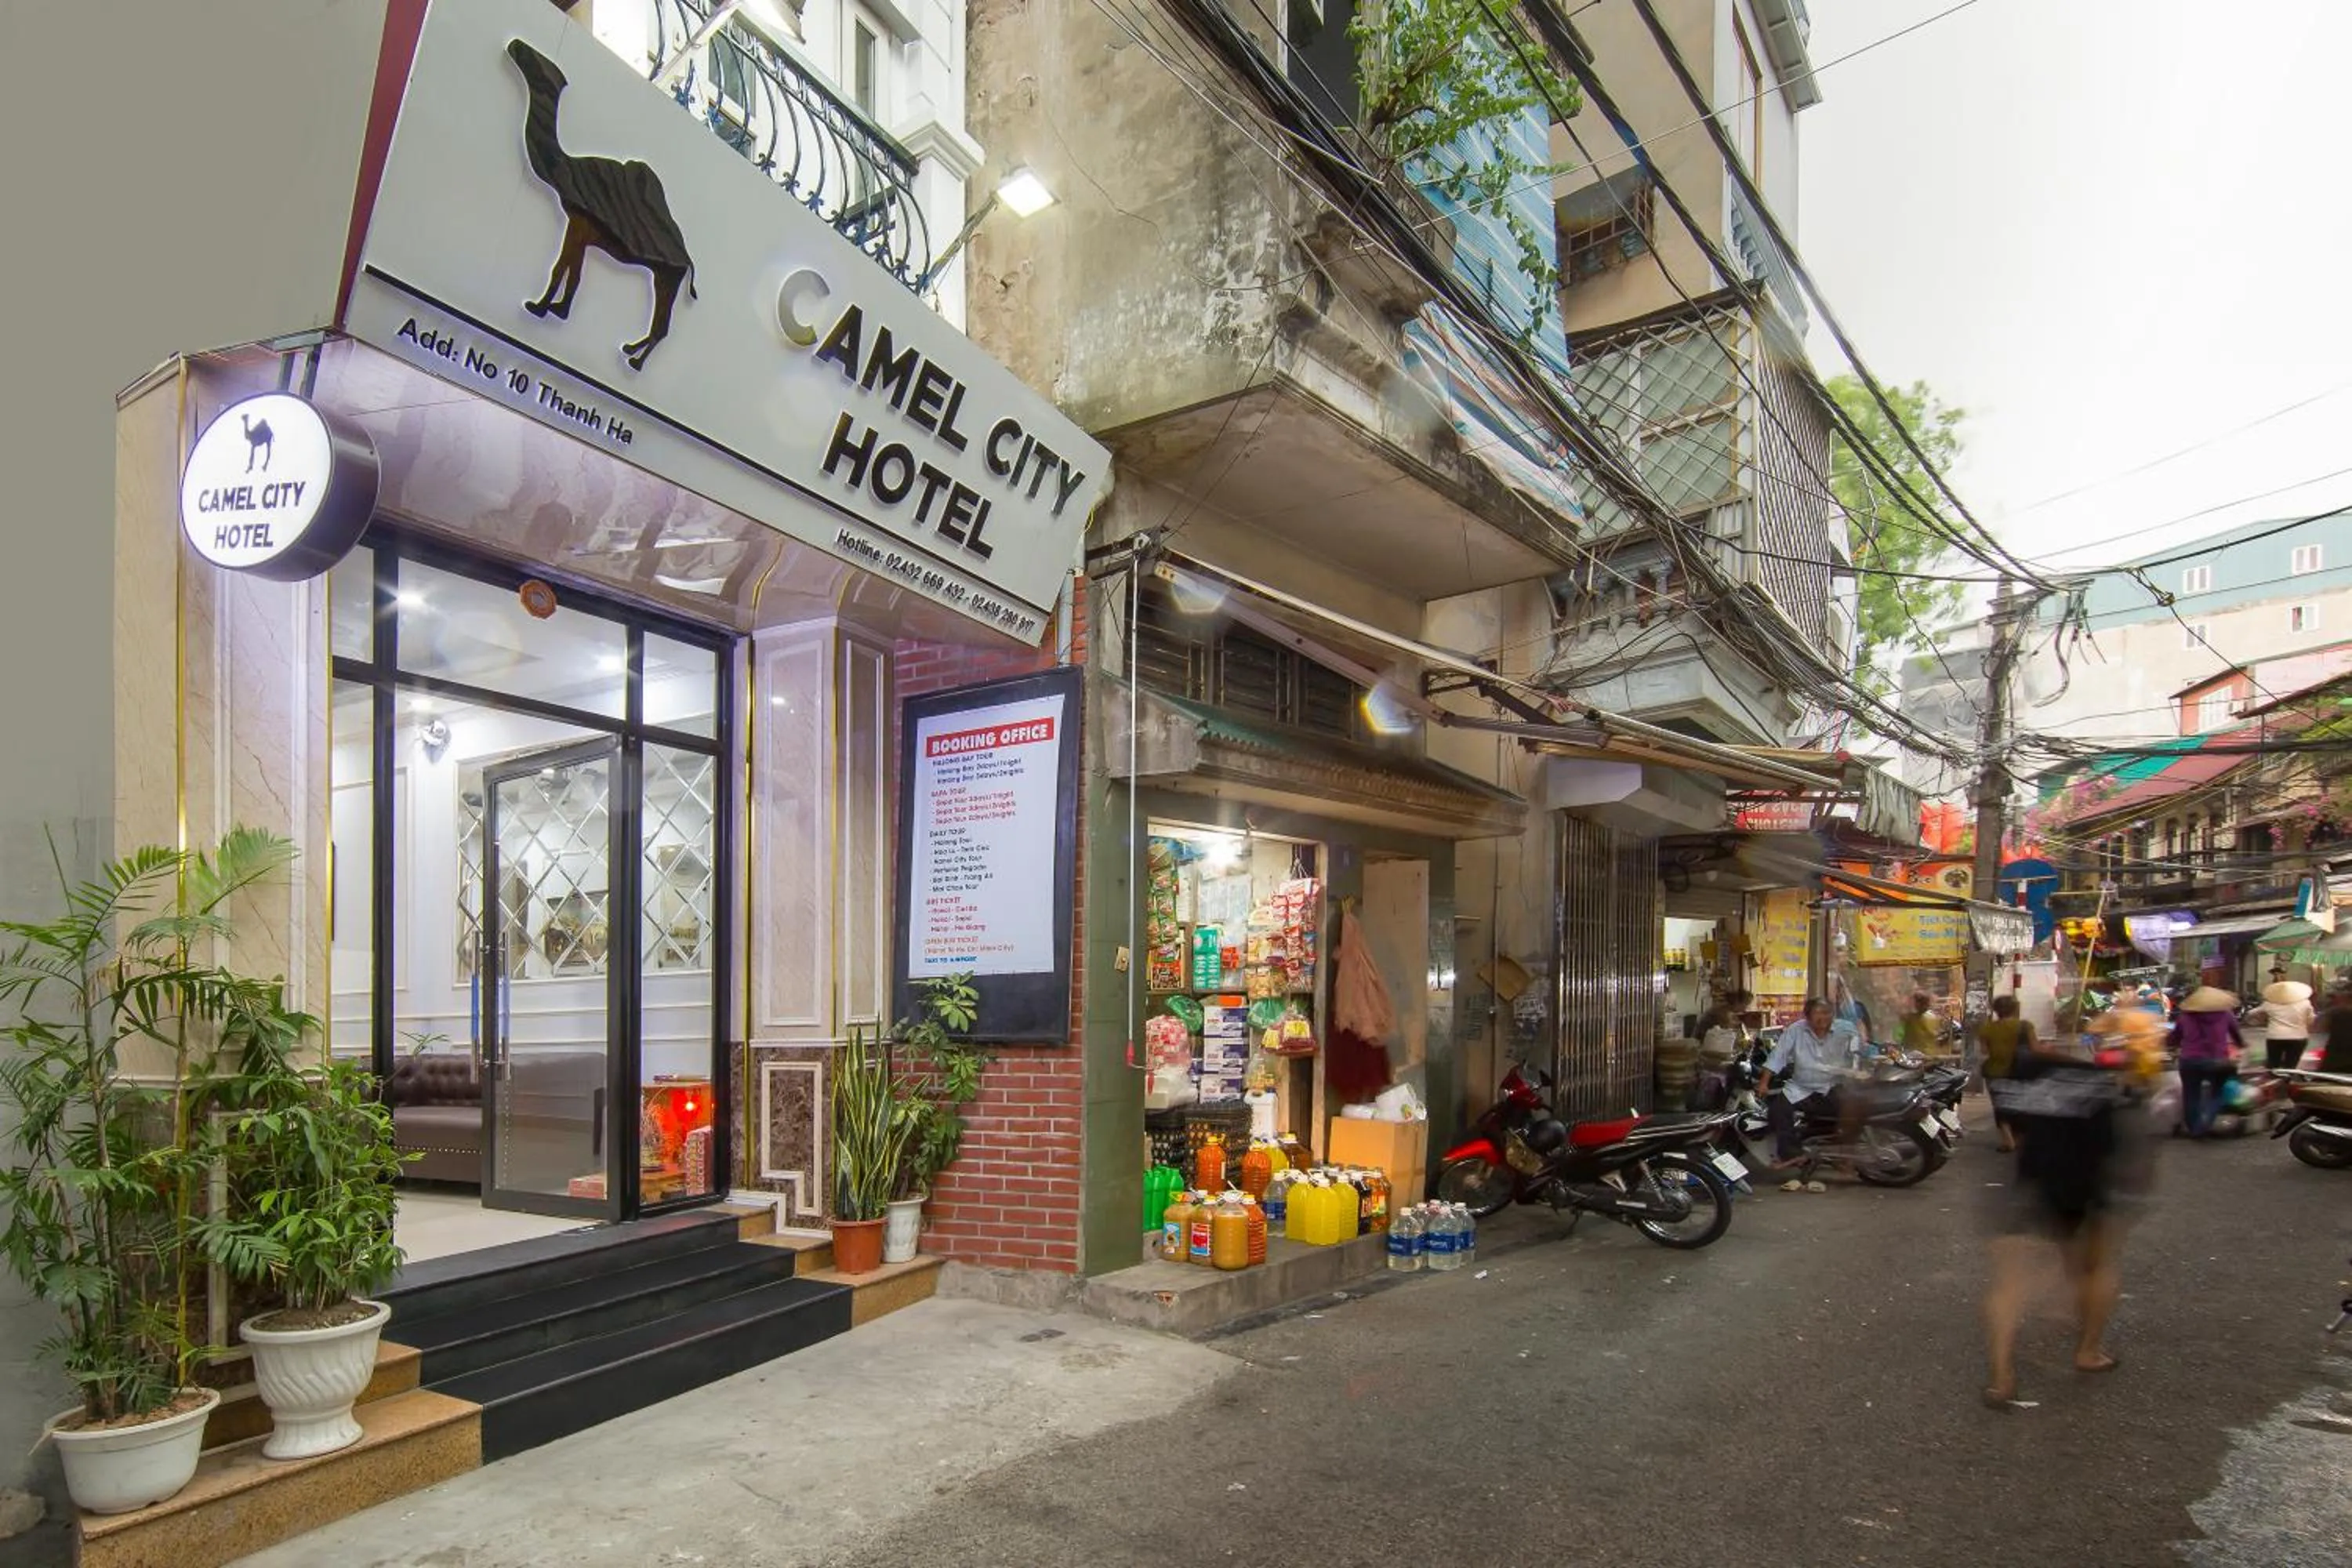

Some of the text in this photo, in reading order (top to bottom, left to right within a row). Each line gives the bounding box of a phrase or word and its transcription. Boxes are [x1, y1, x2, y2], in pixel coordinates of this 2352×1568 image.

[397, 317, 633, 445] Add: No 10 Thanh Ha
[777, 267, 1086, 516] CAMEL CITY
[198, 481, 307, 513] CAMEL CITY
[821, 410, 993, 561] HOTEL
[214, 523, 274, 550] HOTEL
[837, 528, 883, 564] Hotline:
[885, 553, 923, 580] 02432
[923, 570, 945, 590] 669
[932, 724, 1049, 755] BOOKING OFFICE
